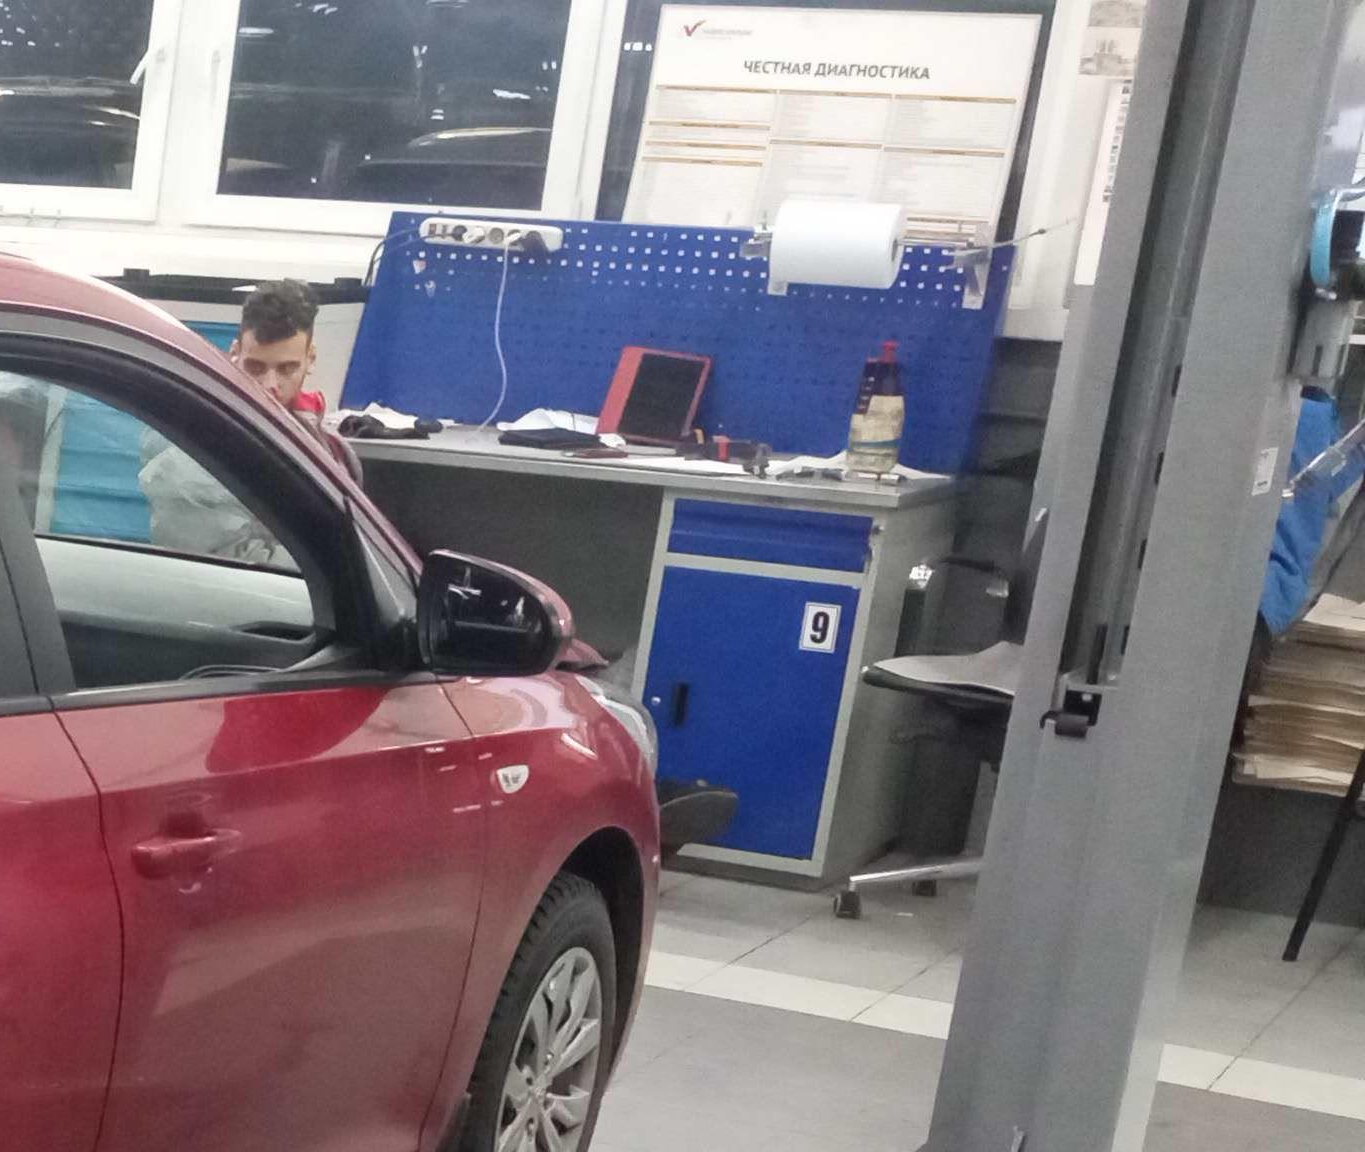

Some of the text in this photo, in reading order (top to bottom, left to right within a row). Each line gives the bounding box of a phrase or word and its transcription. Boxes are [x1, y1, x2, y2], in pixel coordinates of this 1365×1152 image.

[743, 59, 931, 80] ЧЕСТНАЯ ДИАГНОСТИКА
[809, 611, 830, 644] 9
